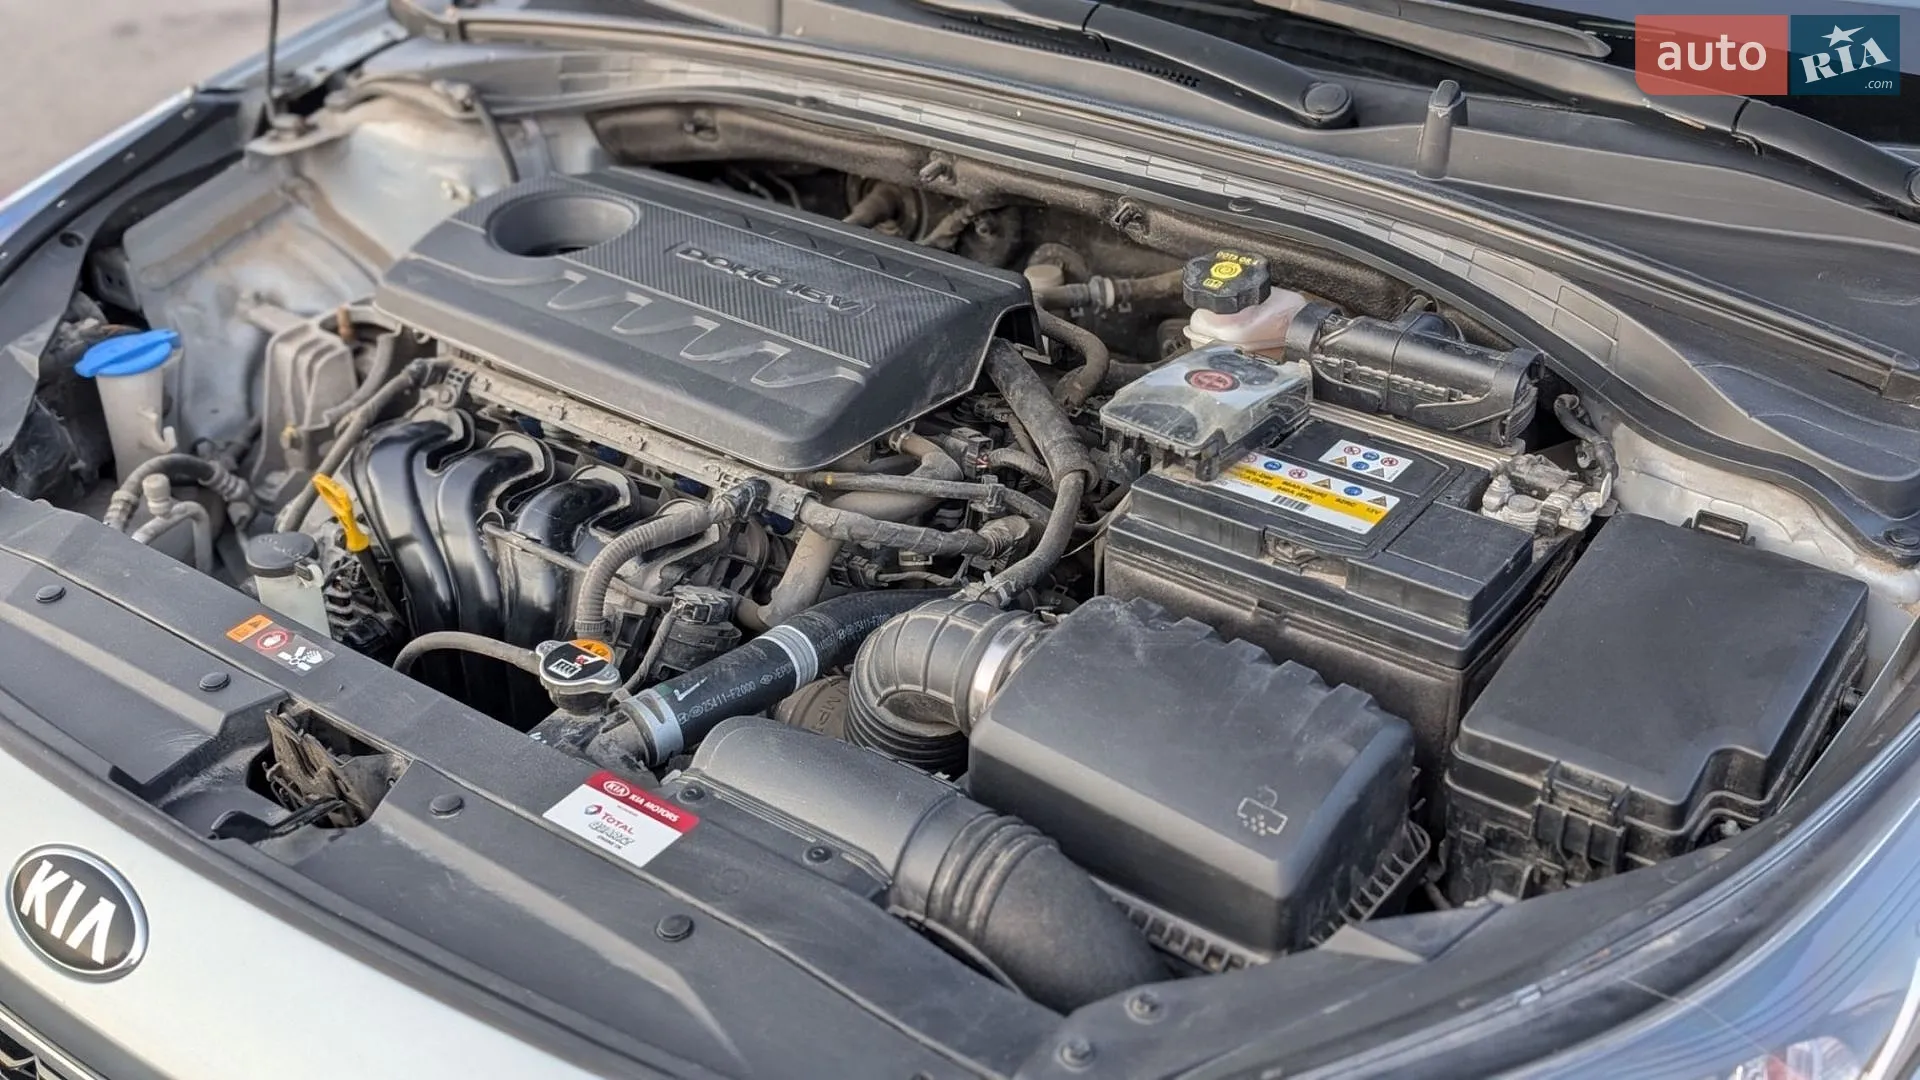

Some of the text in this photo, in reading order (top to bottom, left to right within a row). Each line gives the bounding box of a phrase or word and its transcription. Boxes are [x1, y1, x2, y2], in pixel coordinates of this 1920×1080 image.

[606, 782, 626, 797] KIA
[628, 793, 646, 806] KIA
[643, 801, 681, 823] MOTORS
[602, 812, 634, 836] TOTAL
[20, 859, 117, 965] KIA
